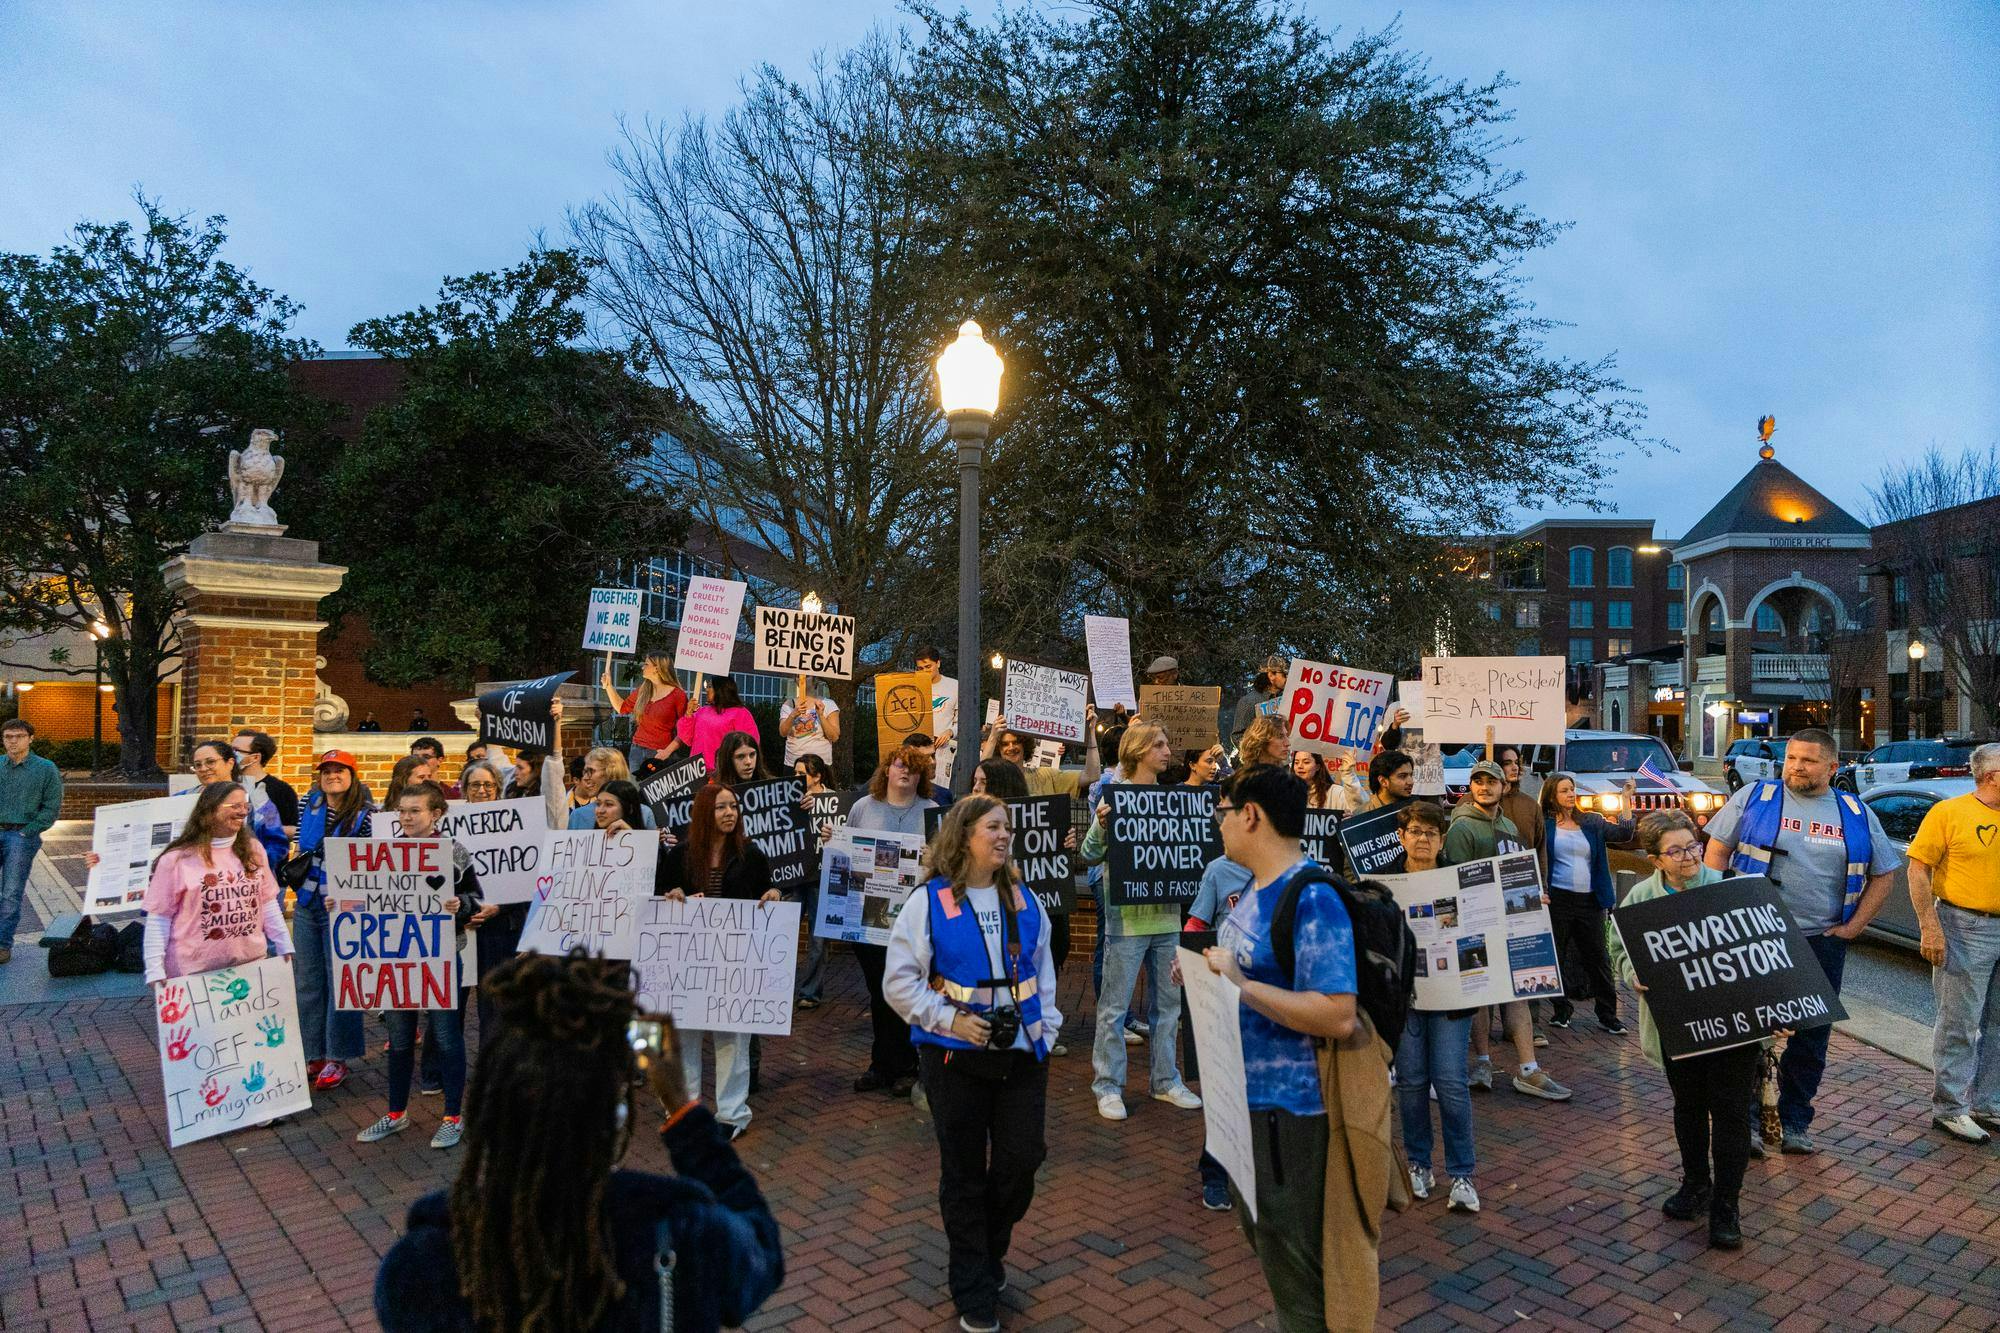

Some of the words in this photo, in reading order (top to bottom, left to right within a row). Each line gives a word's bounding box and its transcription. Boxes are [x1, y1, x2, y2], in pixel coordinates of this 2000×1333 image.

[1768, 538, 1802, 547] TOOMER
[1806, 538, 1832, 547] PLACE
[592, 590, 640, 608] TOGETHER,
[692, 592, 725, 603] CRUELTY
[703, 583, 725, 593] WHEN
[597, 611, 609, 625] WE
[613, 612, 629, 627] ARE
[688, 614, 720, 626] NORMAL
[694, 603, 729, 616] BECOMES
[681, 626, 732, 641] COMPASSION
[763, 610, 790, 627] NO
[793, 614, 854, 636] HUMAN
[589, 633, 630, 648] AMERICA
[689, 638, 724, 650] BECOMES
[765, 628, 824, 651] BEING
[828, 635, 845, 655] IS
[768, 648, 850, 676] ILLEGAL
[1010, 661, 1040, 678] WORST
[1059, 672, 1088, 690] WORST
[1300, 667, 1322, 684] NO
[1328, 670, 1382, 696] SECRET
[503, 690, 525, 713] OF
[891, 697, 916, 712] ICE
[1153, 690, 1184, 704] THESE
[1190, 692, 1206, 702] ARE
[1425, 696, 1461, 716] IS
[1470, 698, 1482, 718] A
[486, 714, 546, 747] FASCISM
[1289, 688, 1384, 750] POLICE
[644, 758, 706, 804] NORMALIZING
[669, 800, 694, 828] ACC
[744, 780, 804, 812] OTHERS
[810, 796, 839, 814] ING
[1010, 802, 1050, 828] THE
[1114, 791, 1214, 817] PROTECTING
[441, 808, 524, 836] AMERICA
[742, 806, 793, 837] RIMES
[1114, 818, 1213, 842] CORPORATE
[1304, 814, 1338, 836] ING
[1782, 817, 1802, 832] IG
[552, 832, 634, 870] FAMILIES
[752, 828, 806, 858] MMIT
[1024, 829, 1056, 854] ON
[1298, 839, 1330, 863] CAL
[1350, 840, 1376, 858] WHITE
[1377, 830, 1401, 848] SUPRE
[348, 842, 440, 872] HATE
[470, 846, 538, 877] STAPO
[1134, 845, 1204, 870] POWER
[1361, 860, 1372, 872] IS
[1372, 846, 1404, 868] TERROR
[334, 874, 382, 890] WILL
[388, 874, 422, 890] NOT
[553, 869, 618, 902] BELONG
[770, 863, 804, 882] CISM
[1124, 881, 1148, 898] THIS
[1154, 880, 1164, 896] IS
[1170, 880, 1201, 896] FASCI
[227, 902, 242, 912] LA
[366, 894, 414, 912] MAKE
[418, 894, 442, 914] US
[539, 898, 632, 936] TOGETHER
[978, 910, 999, 921] IVE
[210, 912, 254, 927] MIGRA
[980, 924, 1000, 935] SIST
[1644, 903, 1786, 962] REWRITING
[333, 912, 452, 960] GREAT
[638, 932, 790, 964] DETAINING
[1680, 938, 1794, 991] HISTORY
[338, 960, 451, 1009] AGAIN
[667, 964, 768, 996] WITHOUT
[186, 967, 280, 1028] Hands
[638, 994, 687, 1021] DUE
[706, 996, 788, 1025] PROCESS
[1684, 1018, 1728, 1042] THIS
[1732, 1012, 1750, 1034] IS
[1755, 994, 1828, 1028] FASCISM
[194, 1032, 247, 1071] OFF
[168, 1061, 302, 1132] Immigrants!
